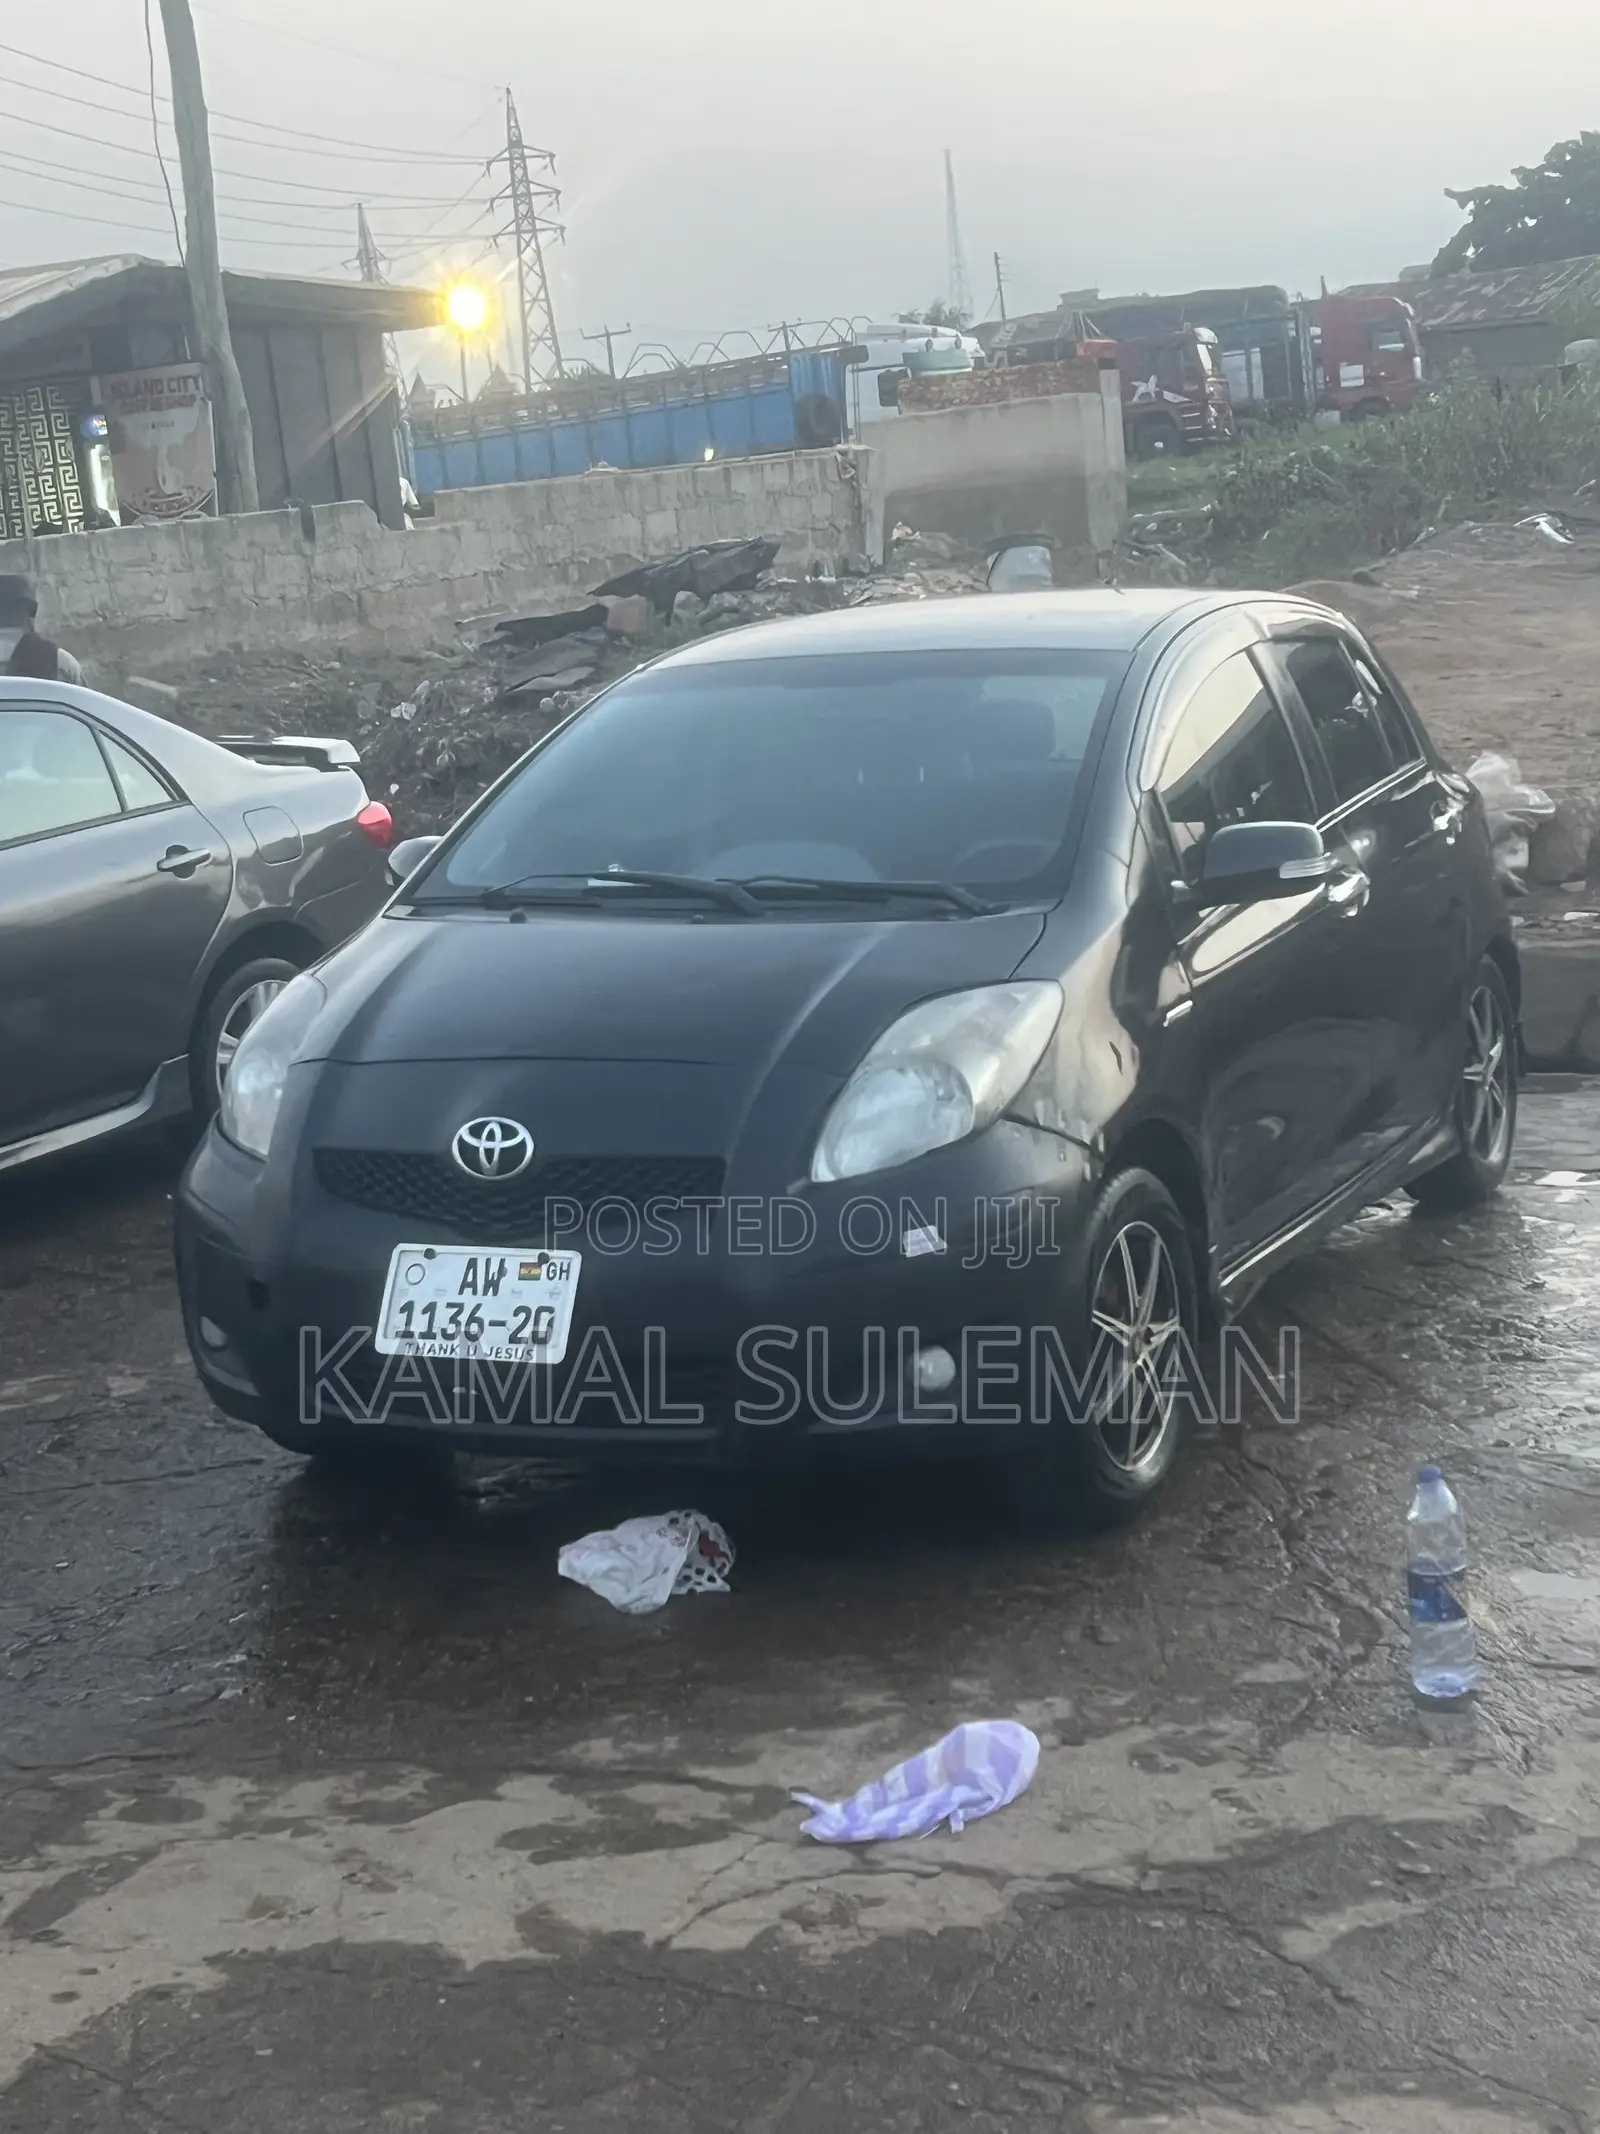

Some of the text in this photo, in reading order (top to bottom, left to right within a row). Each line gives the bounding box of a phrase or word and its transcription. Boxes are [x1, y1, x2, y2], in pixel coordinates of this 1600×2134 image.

[167, 374, 200, 393] CITY
[457, 1257, 571, 1297] AW GH
[394, 1299, 556, 1345] 1136-20
[405, 1342, 460, 1357] THANK
[484, 1346, 534, 1361] JESUS
